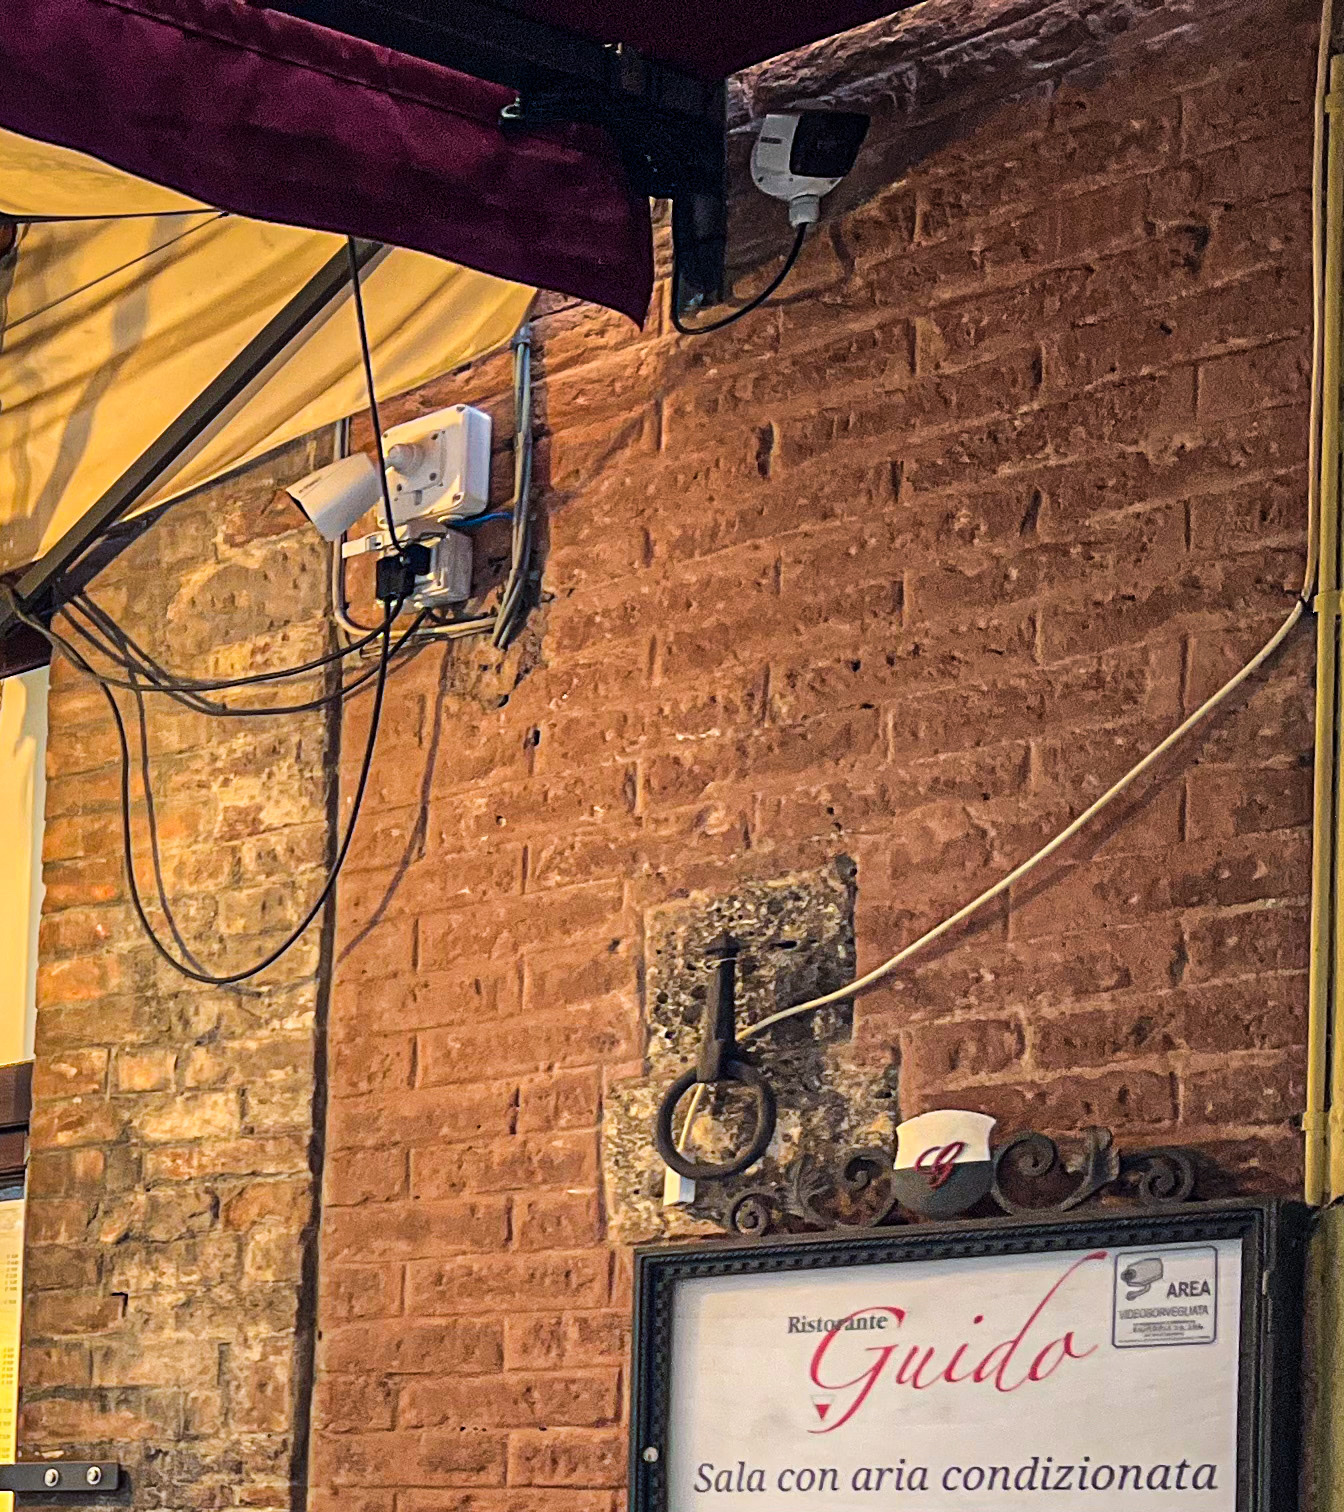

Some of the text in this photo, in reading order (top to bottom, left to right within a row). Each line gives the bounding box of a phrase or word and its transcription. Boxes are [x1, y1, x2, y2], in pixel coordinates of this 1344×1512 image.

[1167, 1279, 1211, 1299] AREA
[787, 1313, 889, 1334] Ristorante
[807, 1250, 1108, 1434] Guido
[694, 1456, 1219, 1494] Sala con aria condizionata
